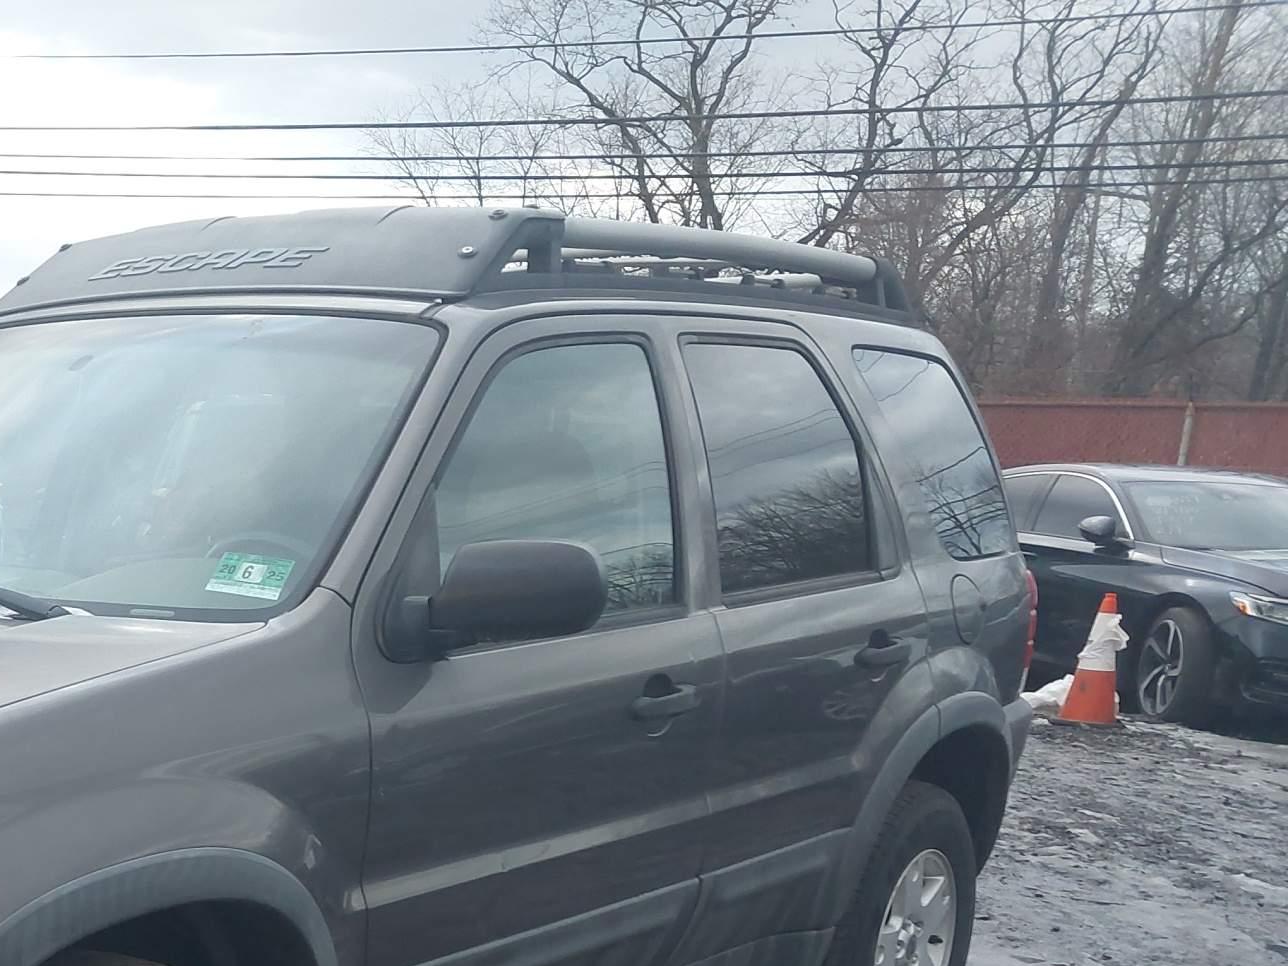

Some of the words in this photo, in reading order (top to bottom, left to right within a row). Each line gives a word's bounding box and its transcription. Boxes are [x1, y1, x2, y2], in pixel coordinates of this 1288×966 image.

[88, 246, 330, 281] ESCAPE
[219, 564, 237, 575] 20
[242, 565, 254, 579] 6
[266, 571, 286, 581] 25
